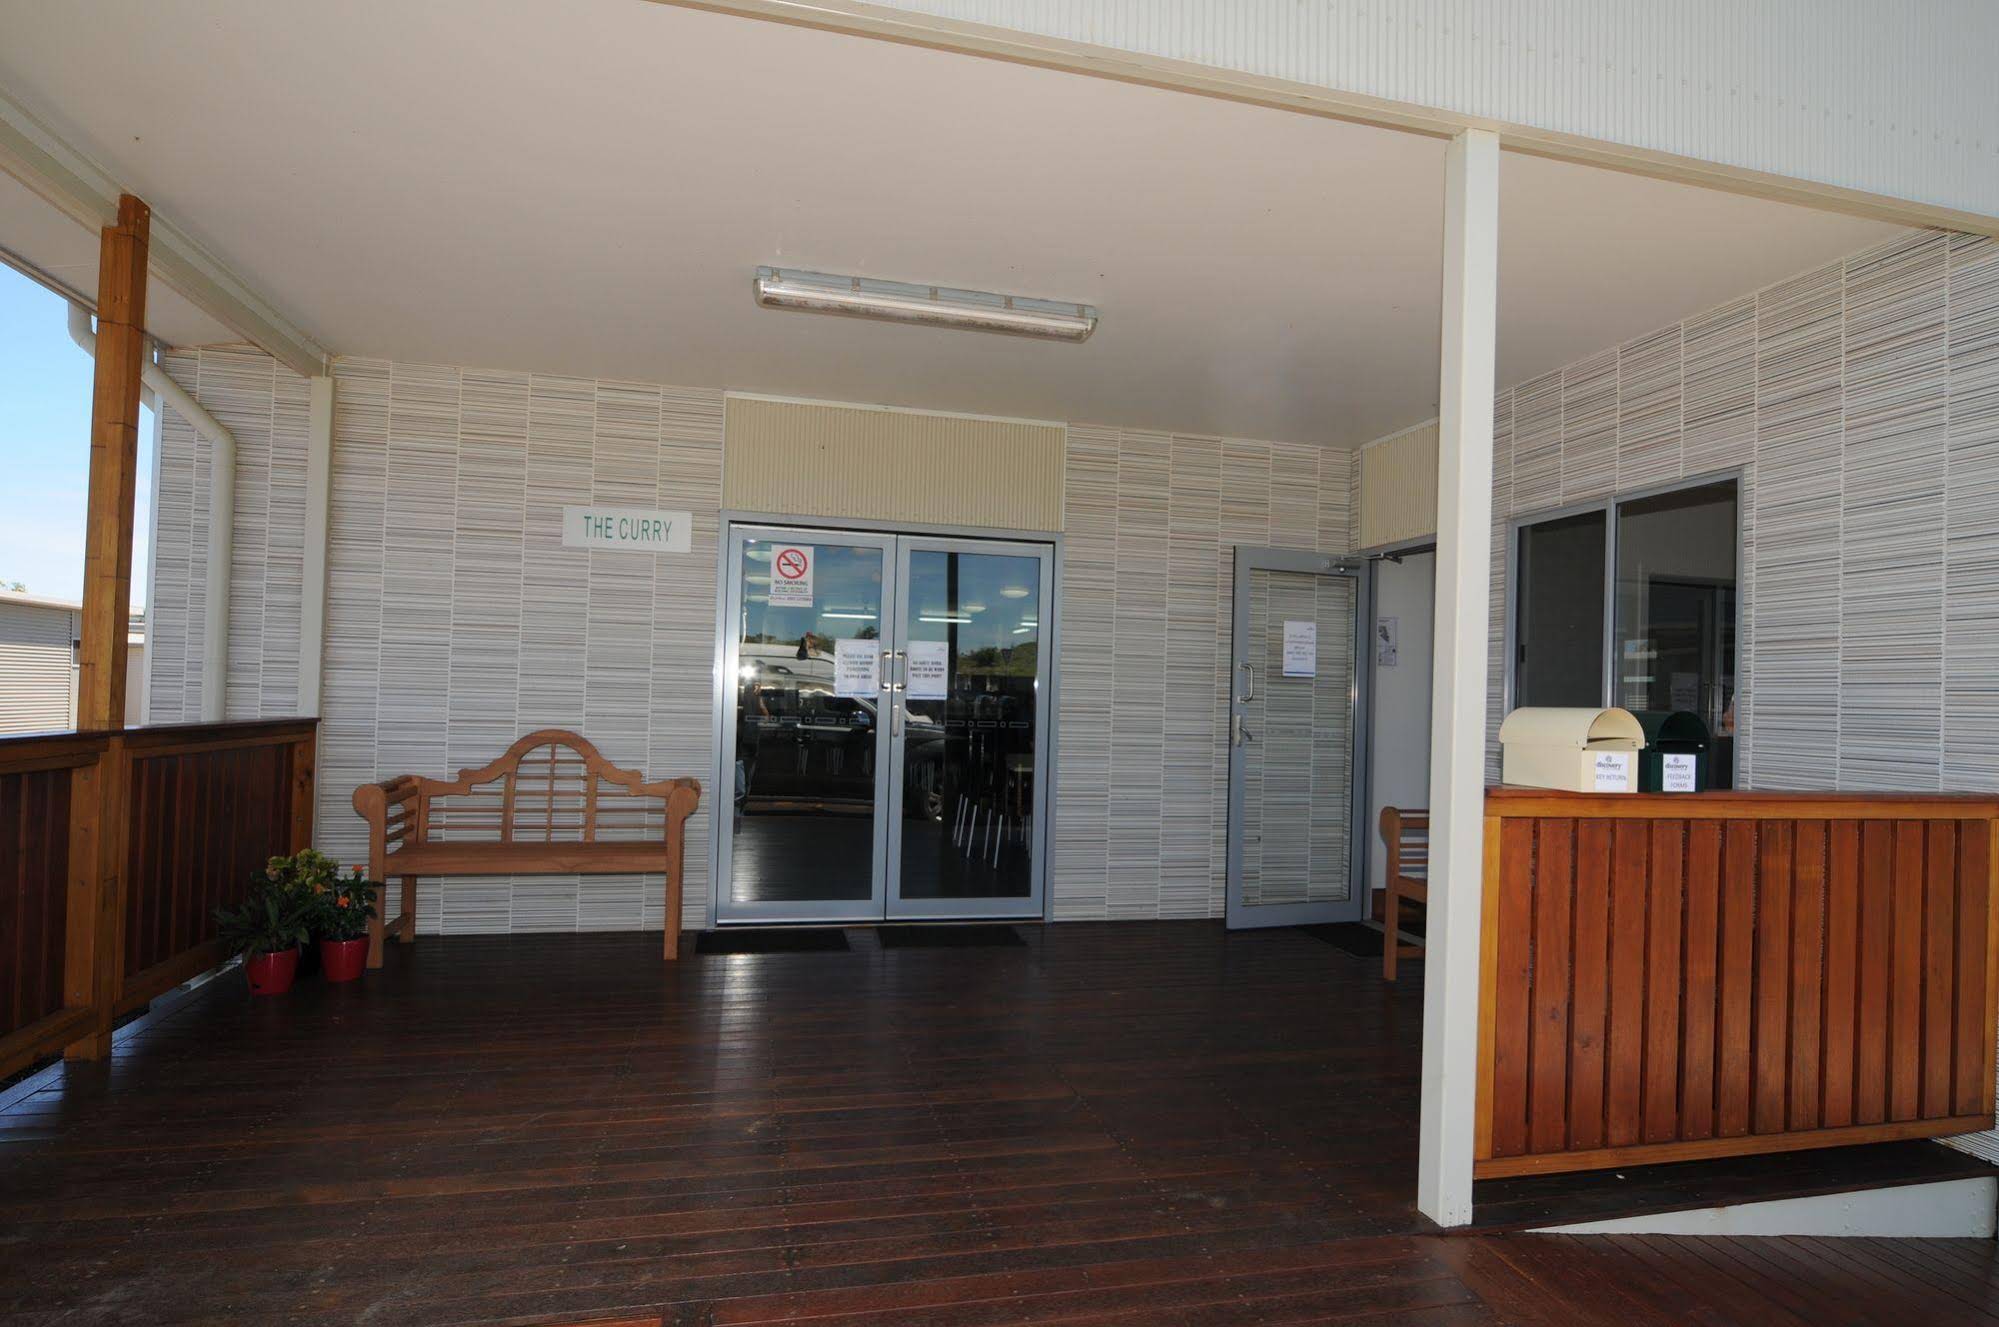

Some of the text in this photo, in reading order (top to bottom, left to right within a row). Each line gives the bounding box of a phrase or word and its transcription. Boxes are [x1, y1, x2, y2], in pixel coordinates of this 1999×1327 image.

[583, 515, 672, 542] THE CURRY
[1596, 761, 1621, 770] discovery
